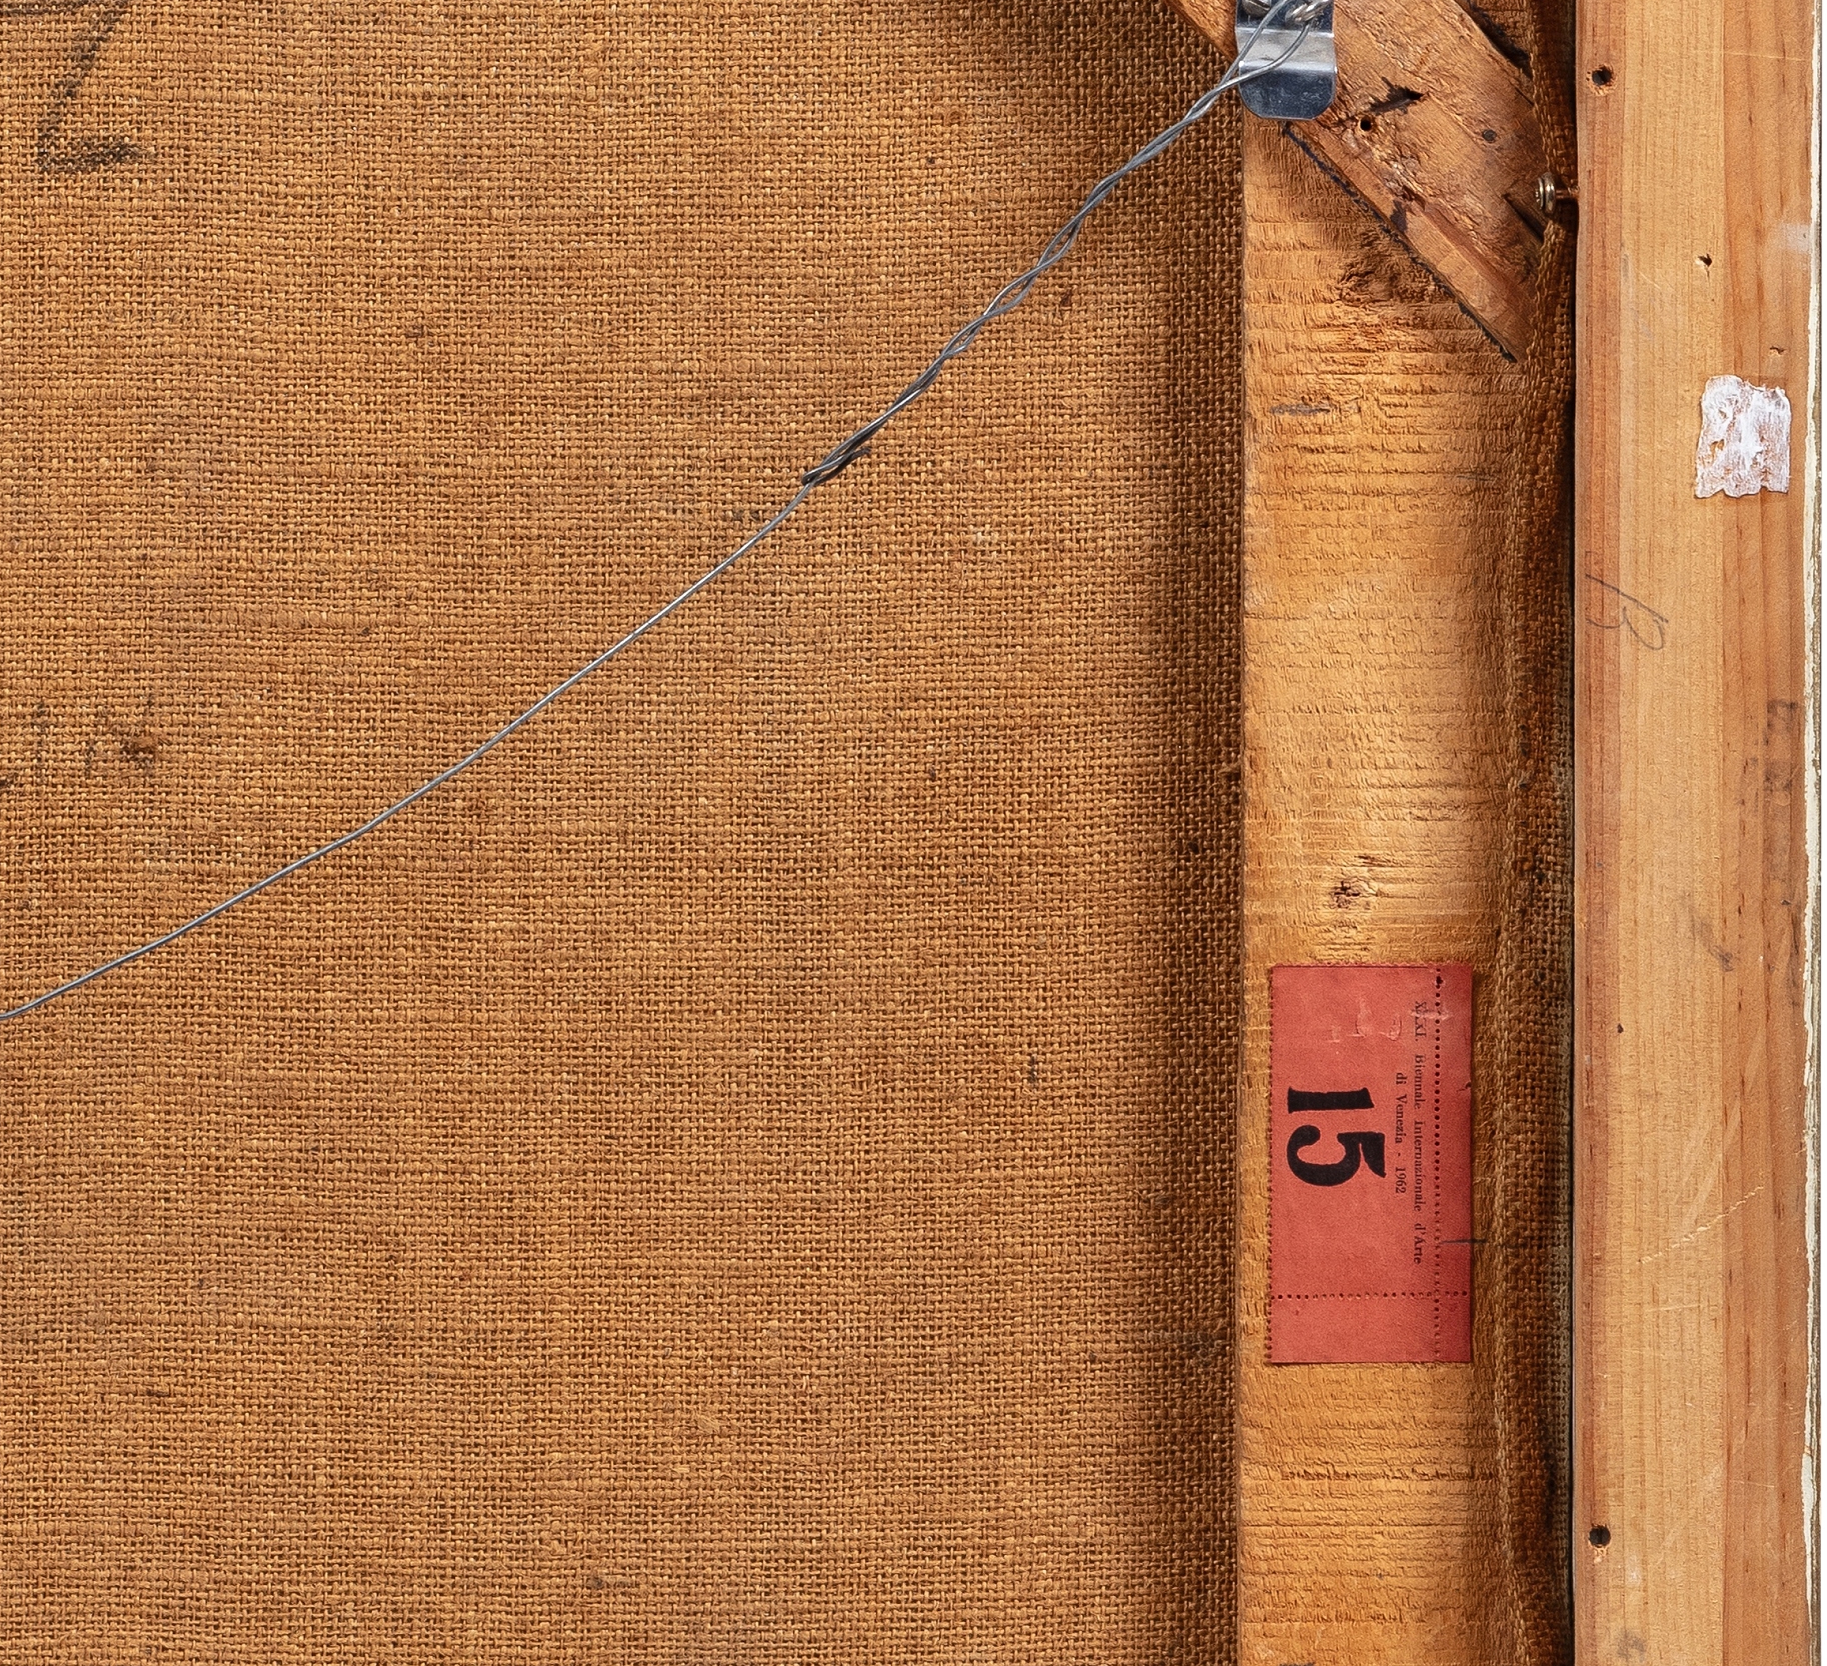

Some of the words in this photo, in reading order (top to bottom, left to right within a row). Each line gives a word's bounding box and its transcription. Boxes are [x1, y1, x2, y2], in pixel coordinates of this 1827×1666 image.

[1395, 1072, 1407, 1085] di
[1413, 1054, 1425, 1110] Biennale
[1287, 1086, 1387, 1187] 15
[1395, 1094, 1407, 1144] Venezia
[1395, 1166, 1407, 1194] 1962
[1413, 1120, 1425, 1212] Internazionale
[1413, 1223, 1426, 1264] d'Arte
